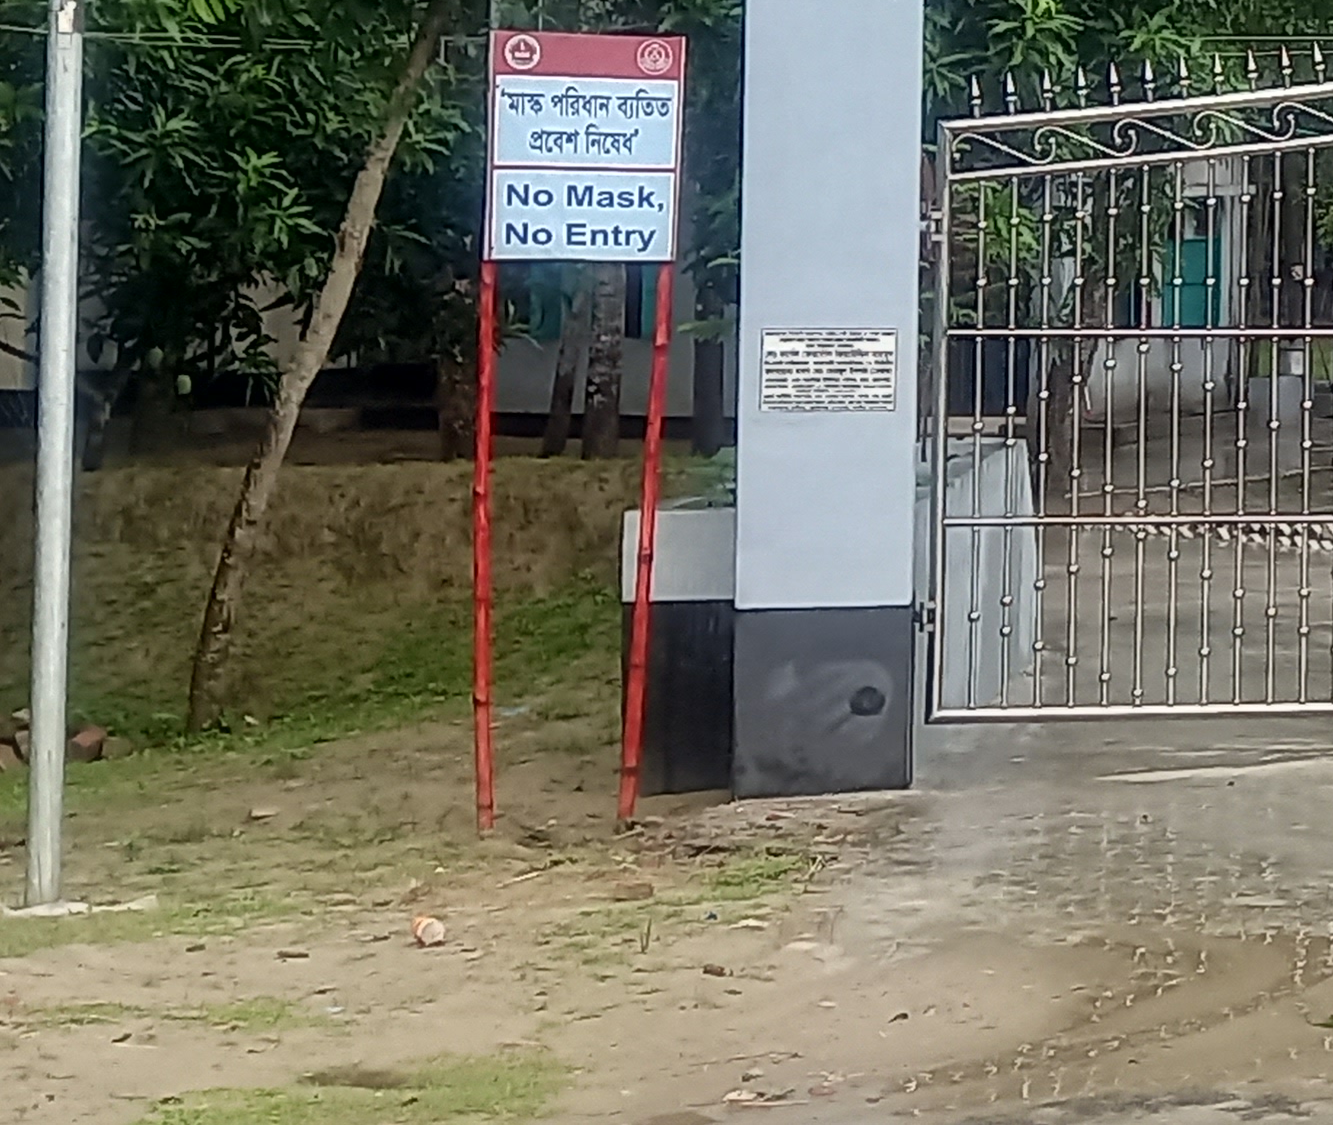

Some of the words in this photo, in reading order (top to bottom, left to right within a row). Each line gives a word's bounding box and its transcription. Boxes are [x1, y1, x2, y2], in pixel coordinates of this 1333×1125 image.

[551, 86, 612, 119] পরিধান
[616, 89, 672, 119] ব্যতিত
[529, 129, 579, 154] প্রবেশ
[506, 184, 554, 207] No
[566, 185, 665, 213] Mask,
[505, 222, 553, 246] No
[566, 223, 657, 253] Entry
